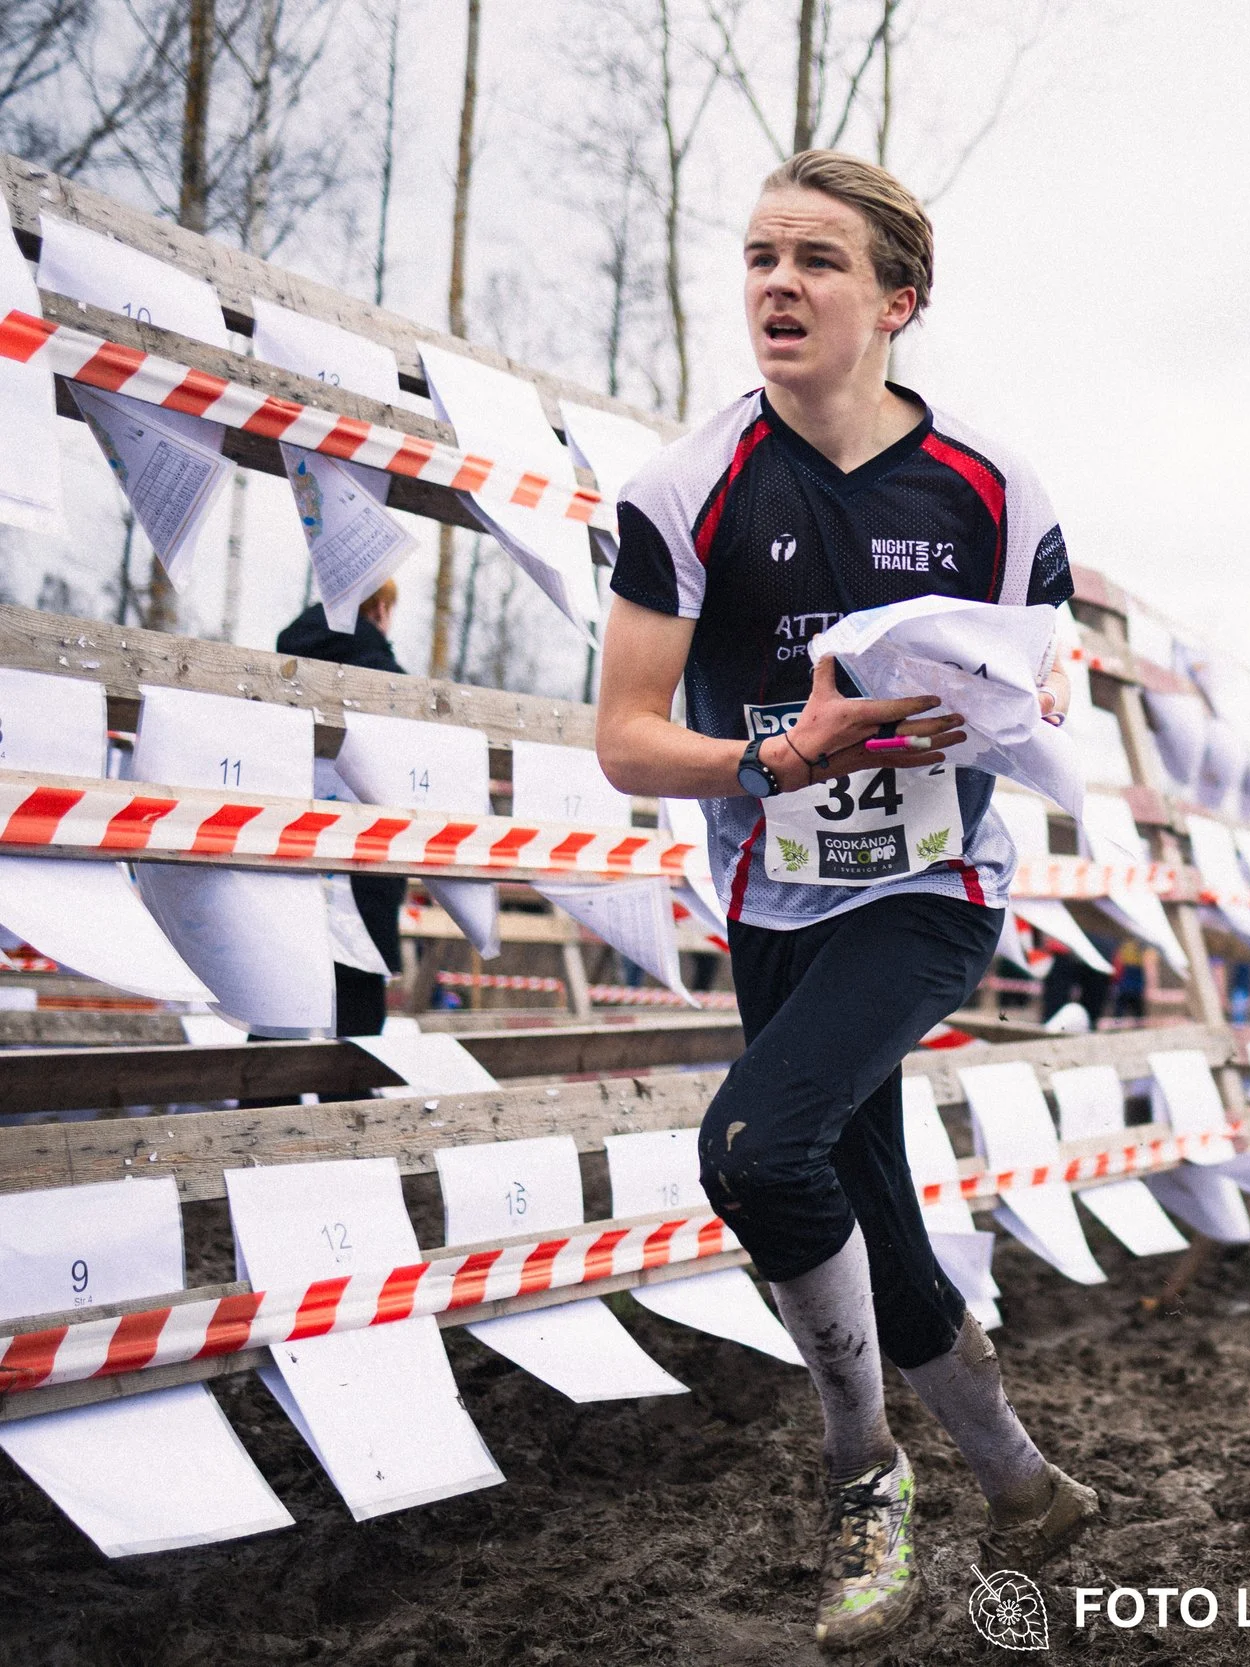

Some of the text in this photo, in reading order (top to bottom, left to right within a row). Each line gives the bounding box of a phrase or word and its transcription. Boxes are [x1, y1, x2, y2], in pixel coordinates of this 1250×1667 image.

[871, 539, 915, 555] NIGHT
[915, 541, 930, 572] RUN
[873, 555, 915, 571] TRAIL
[775, 612, 844, 639] ATT
[777, 645, 807, 661] OR
[220, 758, 242, 787] 11
[409, 767, 430, 793] 14
[563, 794, 582, 817] 17
[815, 767, 903, 821] 34
[825, 834, 896, 850] GODKÄNDA
[505, 1181, 527, 1216] 15
[658, 1183, 680, 1206] 18
[321, 1222, 353, 1251] 12
[71, 1259, 88, 1293] 9
